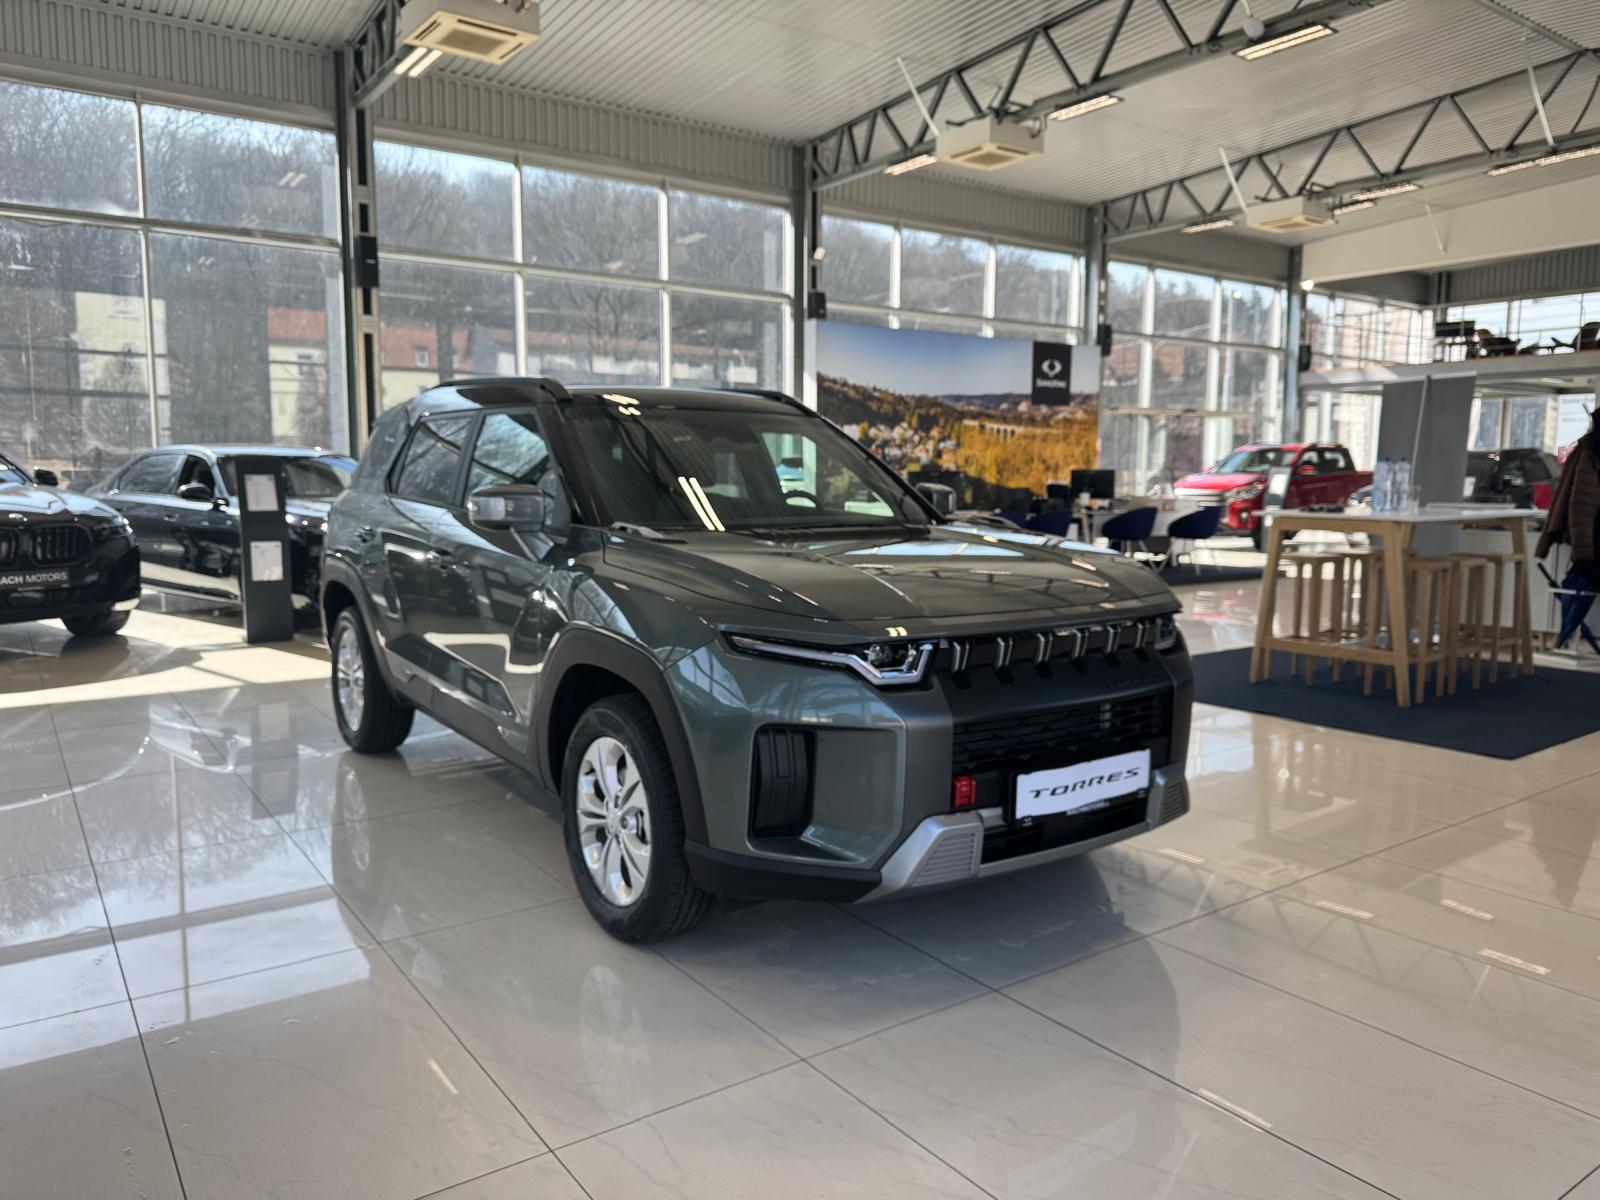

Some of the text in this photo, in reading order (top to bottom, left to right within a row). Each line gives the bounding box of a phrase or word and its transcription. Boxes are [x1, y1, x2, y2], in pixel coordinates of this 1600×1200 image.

[0, 572, 68, 585] ACH MOTORS
[1030, 767, 1140, 798] TORRES
